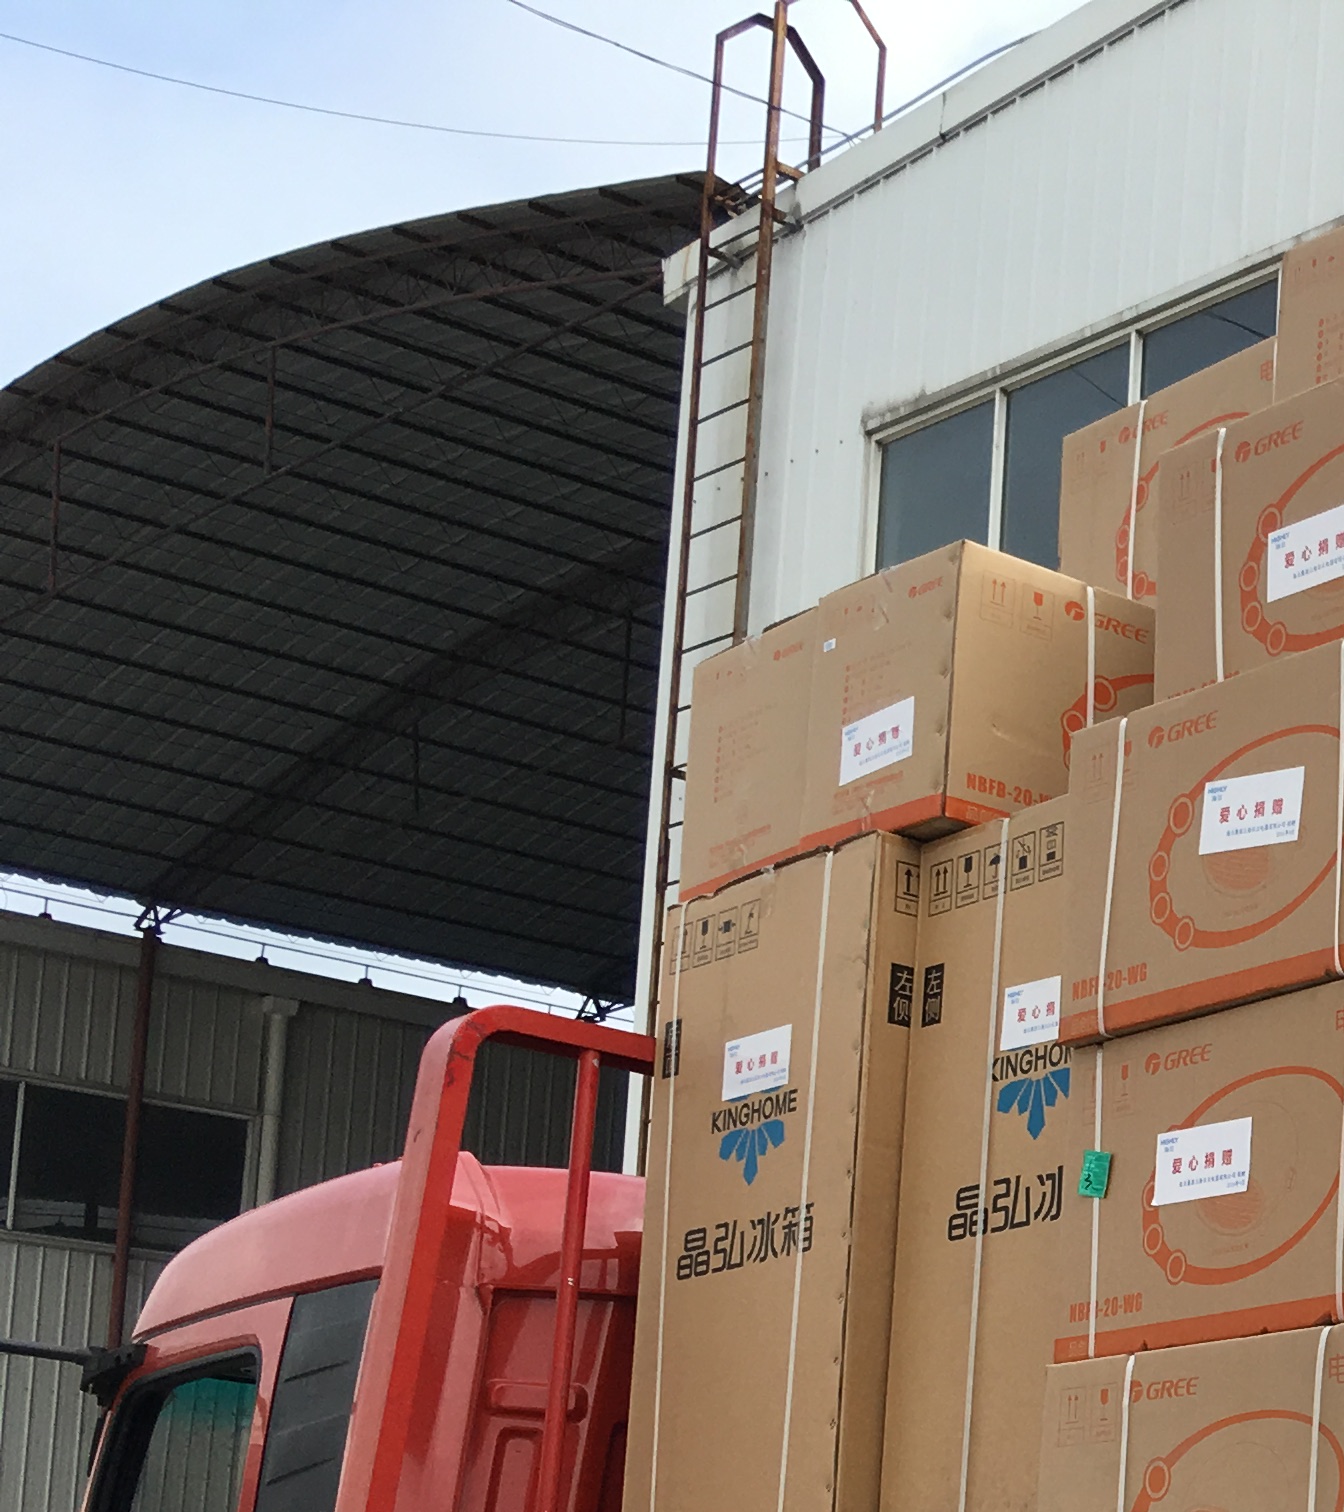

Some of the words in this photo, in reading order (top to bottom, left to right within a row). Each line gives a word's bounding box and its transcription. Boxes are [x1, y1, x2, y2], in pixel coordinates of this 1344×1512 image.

[1254, 420, 1305, 457] GREE
[1093, 613, 1149, 644] GREE
[1168, 710, 1220, 743] GREE
[1219, 797, 1283, 824] 爱心捐赠
[925, 969, 942, 1022] 左侧
[1164, 1043, 1212, 1072] GREE
[711, 1089, 798, 1134] KINGHOME
[1171, 1148, 1234, 1175] 爱心捐赠
[677, 1202, 814, 1280] 晶弘冰箱
[1146, 1376, 1199, 1401] GREE
